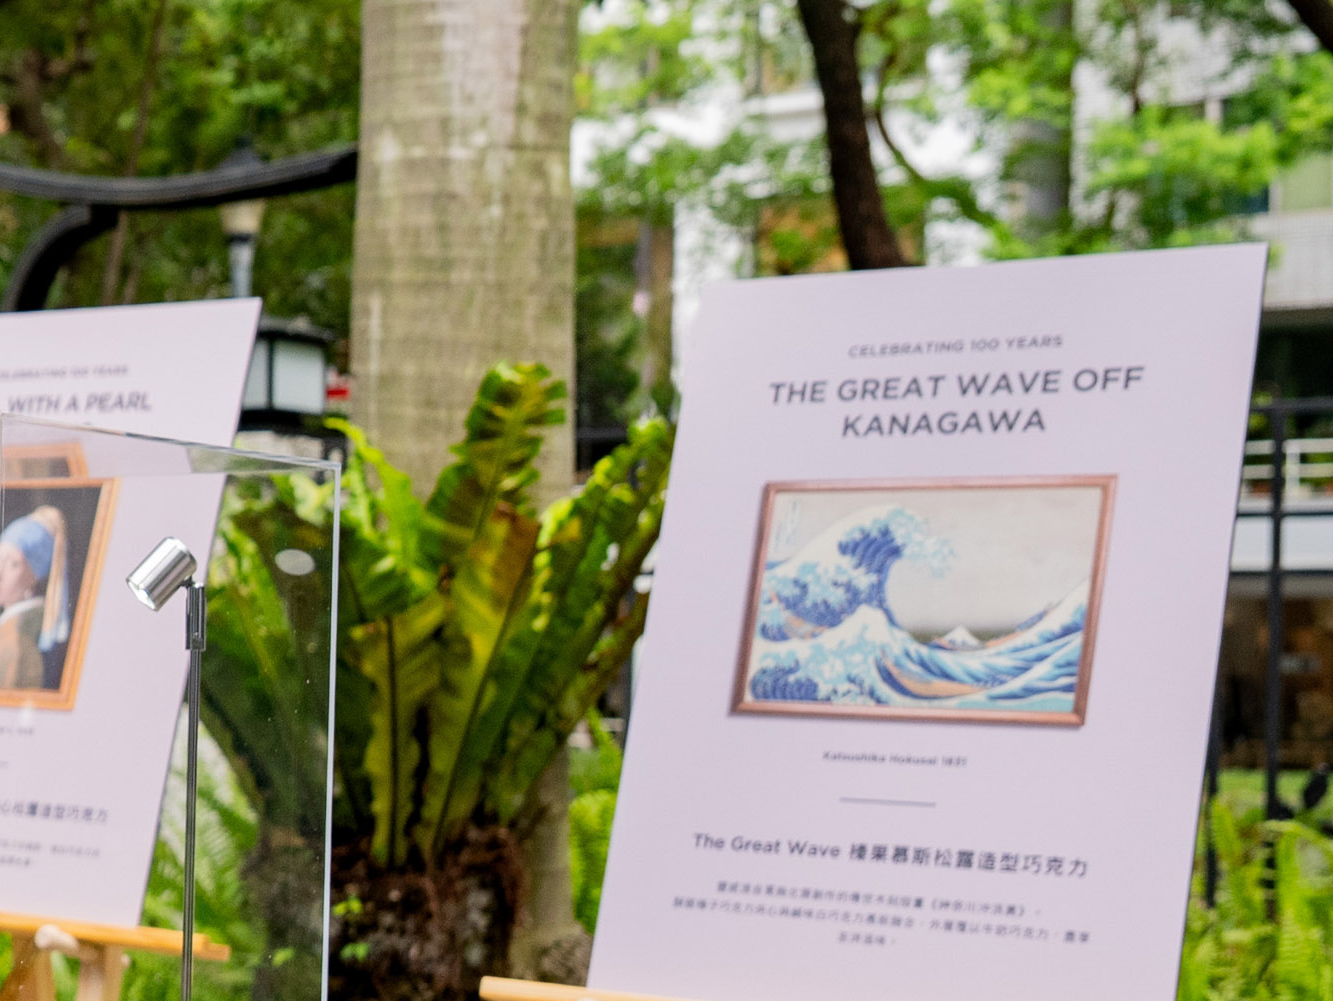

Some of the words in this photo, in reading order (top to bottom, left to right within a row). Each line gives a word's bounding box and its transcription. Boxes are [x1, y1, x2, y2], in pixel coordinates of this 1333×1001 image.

[847, 340, 965, 359] CELEBRATING
[970, 338, 1000, 353] 100
[1006, 335, 1064, 351] YEARS
[770, 379, 828, 404] THE
[837, 374, 946, 402] GREAT
[957, 369, 1063, 397] WAVE
[1073, 365, 1146, 393] OFF
[8, 393, 59, 413] WITH
[64, 393, 81, 413] A
[84, 391, 152, 412] PEARL
[841, 408, 1047, 438] KANAGAWA
[693, 832, 725, 851] The
[730, 835, 781, 856] Great
[787, 840, 842, 861] Wave
